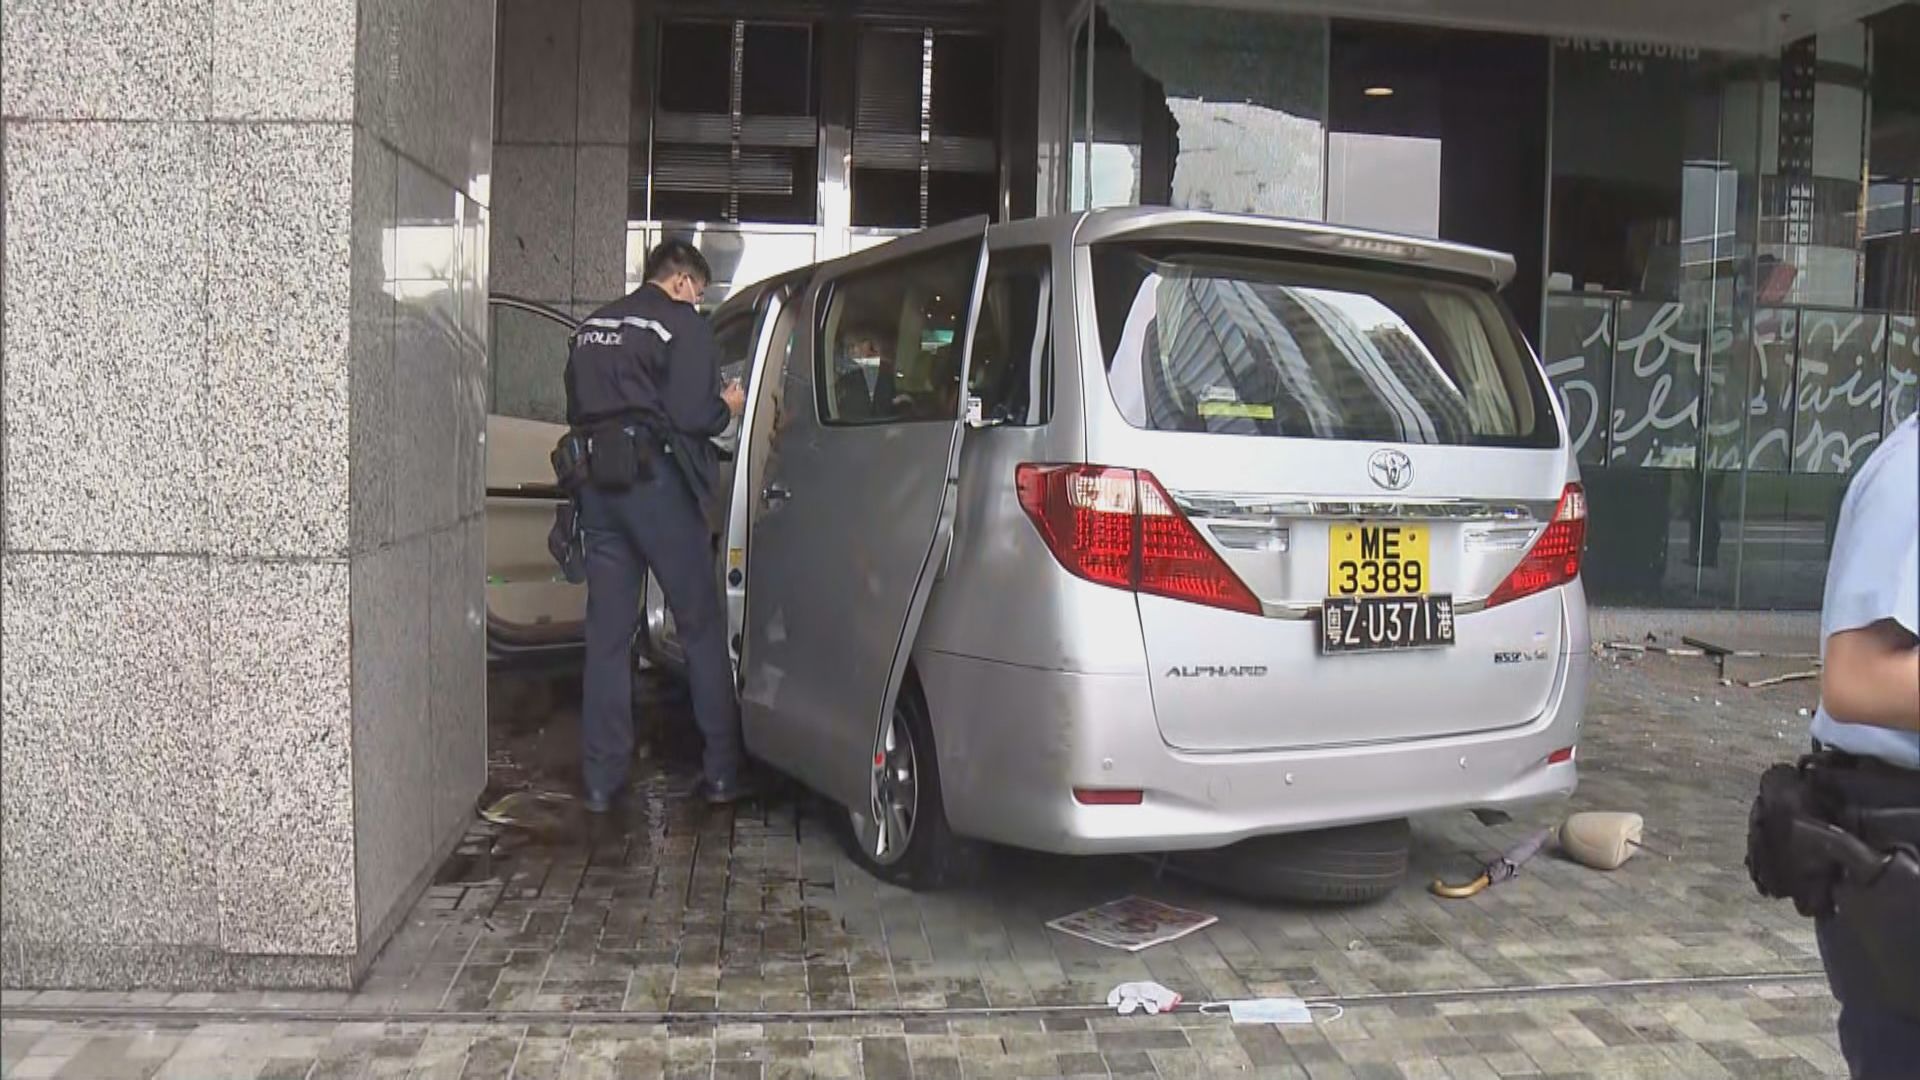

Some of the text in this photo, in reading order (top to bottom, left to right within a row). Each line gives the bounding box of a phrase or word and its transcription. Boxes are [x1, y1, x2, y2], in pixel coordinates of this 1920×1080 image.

[582, 331, 623, 346] POLICE
[1360, 527, 1401, 559] ME
[1338, 560, 1422, 594] 3389
[1165, 665, 1268, 678] ALPHARD
